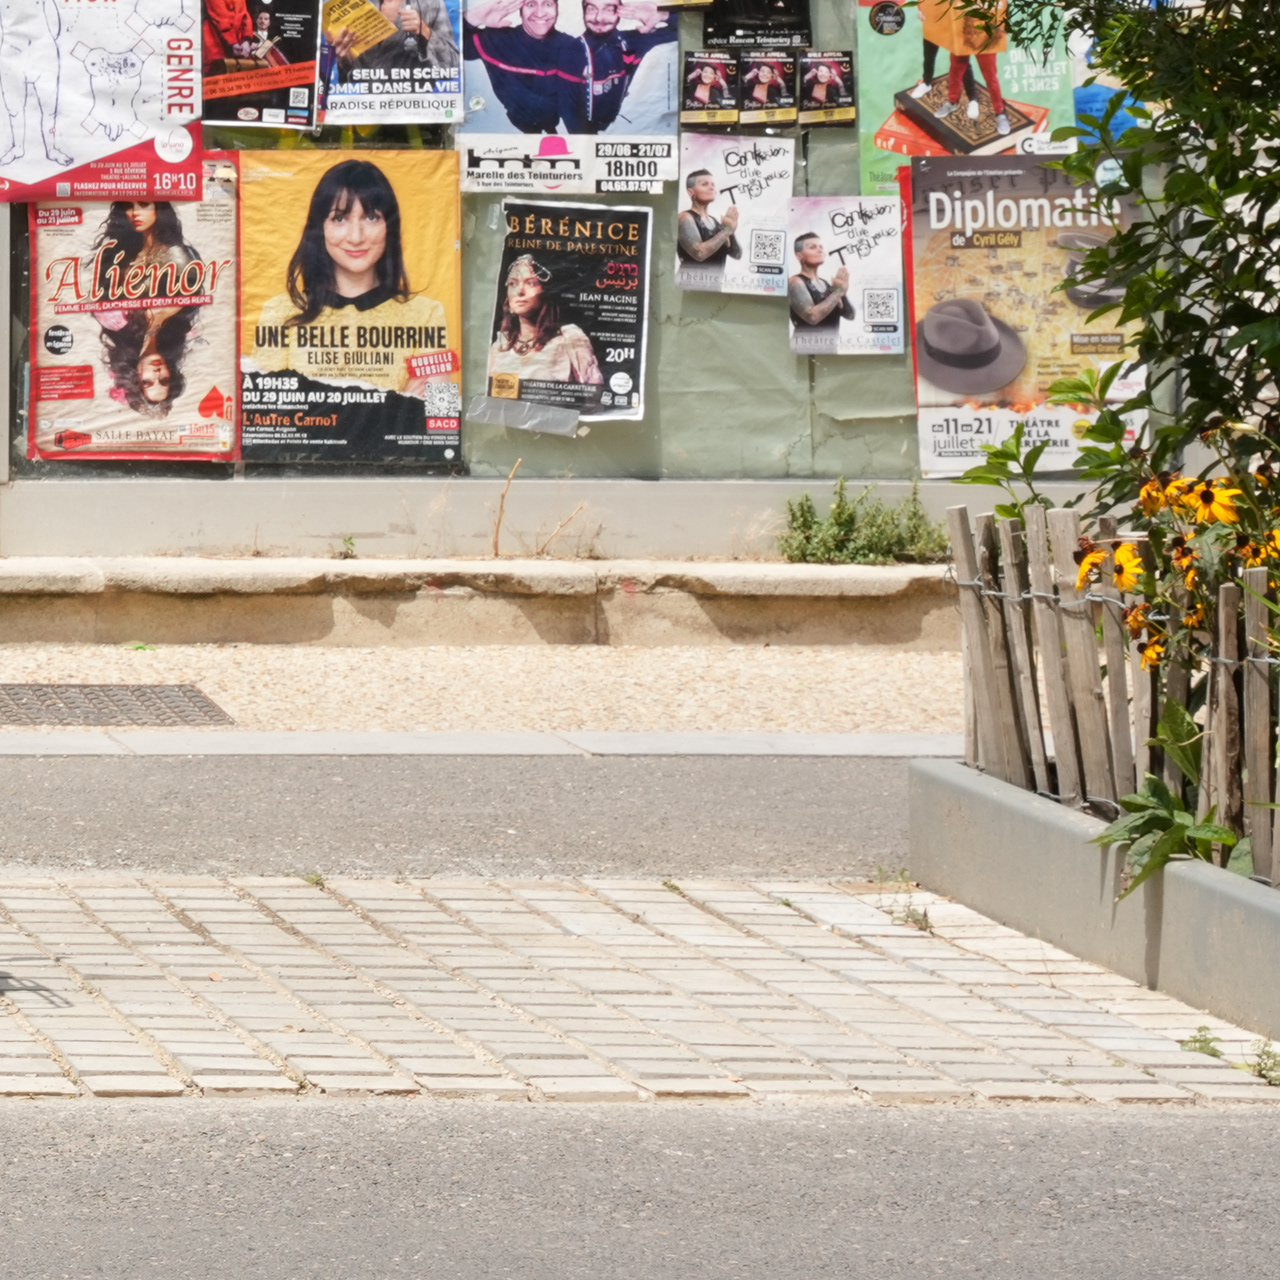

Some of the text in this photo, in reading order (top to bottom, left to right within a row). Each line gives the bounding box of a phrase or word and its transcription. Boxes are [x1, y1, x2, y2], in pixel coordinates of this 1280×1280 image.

[1009, 50, 1024, 64] DU
[166, 37, 195, 115] GENRE
[352, 65, 460, 81] SEUL EN SCÈNE
[1003, 61, 1068, 79] 21 JUILLET
[371, 81, 413, 93] DANS
[414, 81, 434, 93] LA
[436, 81, 460, 93] VIE
[379, 98, 458, 111] RÉPUBLIQUE
[597, 144, 669, 157] 29/06 21/07
[466, 170, 584, 181] Marelle des Teinturiers
[604, 160, 658, 178] 18h00
[869, 171, 894, 183] Théâtre
[152, 172, 197, 190] 16H10
[928, 187, 1122, 238] Diplomatie
[509, 214, 640, 242] BÉRÉNICE
[507, 238, 639, 257] REINE DE PALESTINE
[951, 232, 1020, 247] de Cyril Gély
[45, 238, 232, 303] Aliénor
[54, 295, 212, 314] FEMME LIBRE, DUCHESSE ET DEUX FOIS REINE
[579, 292, 638, 305] JEAN RACINE
[254, 325, 447, 349] UNE BELLE BOURRINE
[307, 351, 395, 366] ELISE GIULIANI
[410, 352, 453, 368] NOUVELLE
[605, 347, 635, 363] 20H
[414, 362, 453, 378] VERSION
[242, 375, 300, 390] À 19H35
[242, 392, 387, 405] DU 29 JUIN AU 20 JUILLET
[428, 419, 458, 429] SACD
[95, 430, 133, 441] SALLE
[136, 430, 176, 441] BAYAF
[932, 434, 975, 454] juillet
